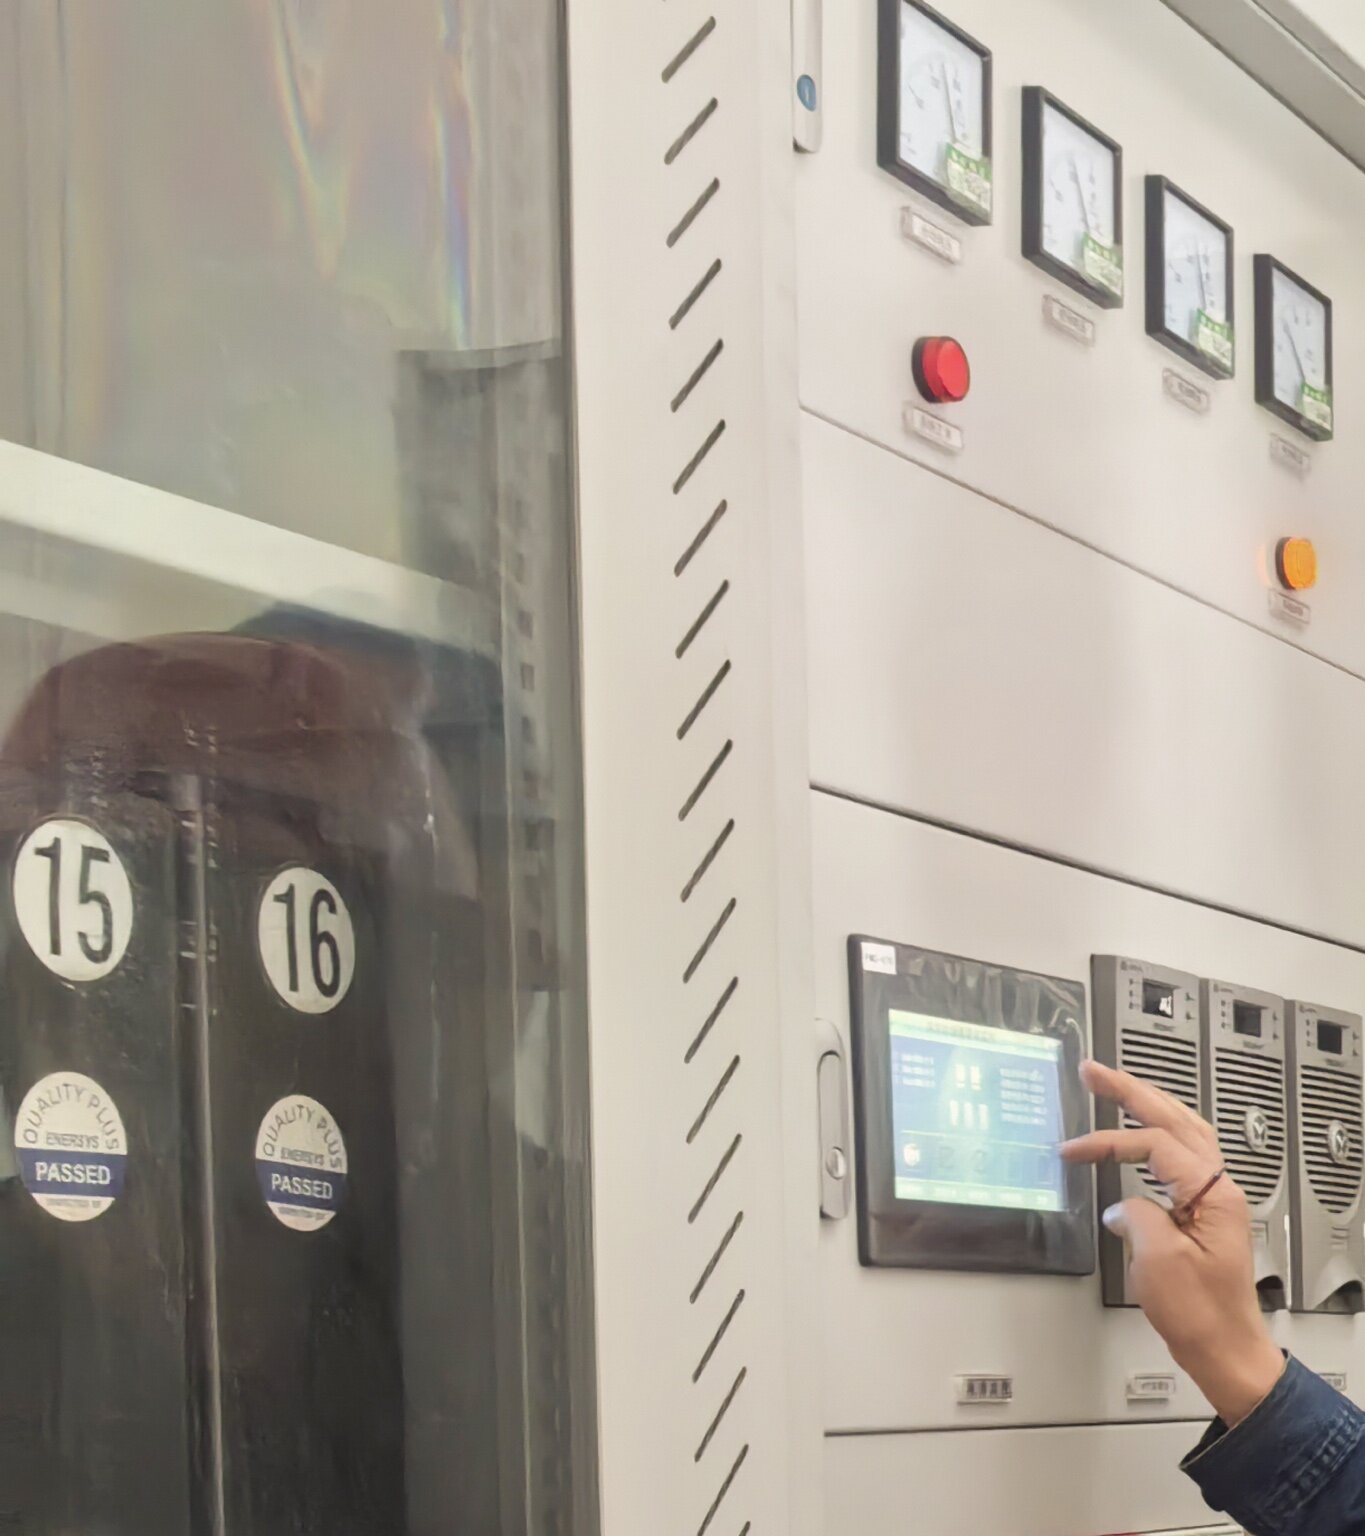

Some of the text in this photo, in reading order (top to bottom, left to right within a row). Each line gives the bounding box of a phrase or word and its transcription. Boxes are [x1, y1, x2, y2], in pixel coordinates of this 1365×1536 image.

[33, 837, 114, 964] 15
[273, 883, 341, 998] 16
[23, 1083, 120, 1150] QUALITY PLUS
[263, 1104, 344, 1169] QUALITY PLUS
[35, 1161, 111, 1185] PASSED
[271, 1173, 333, 1200] PASSED
